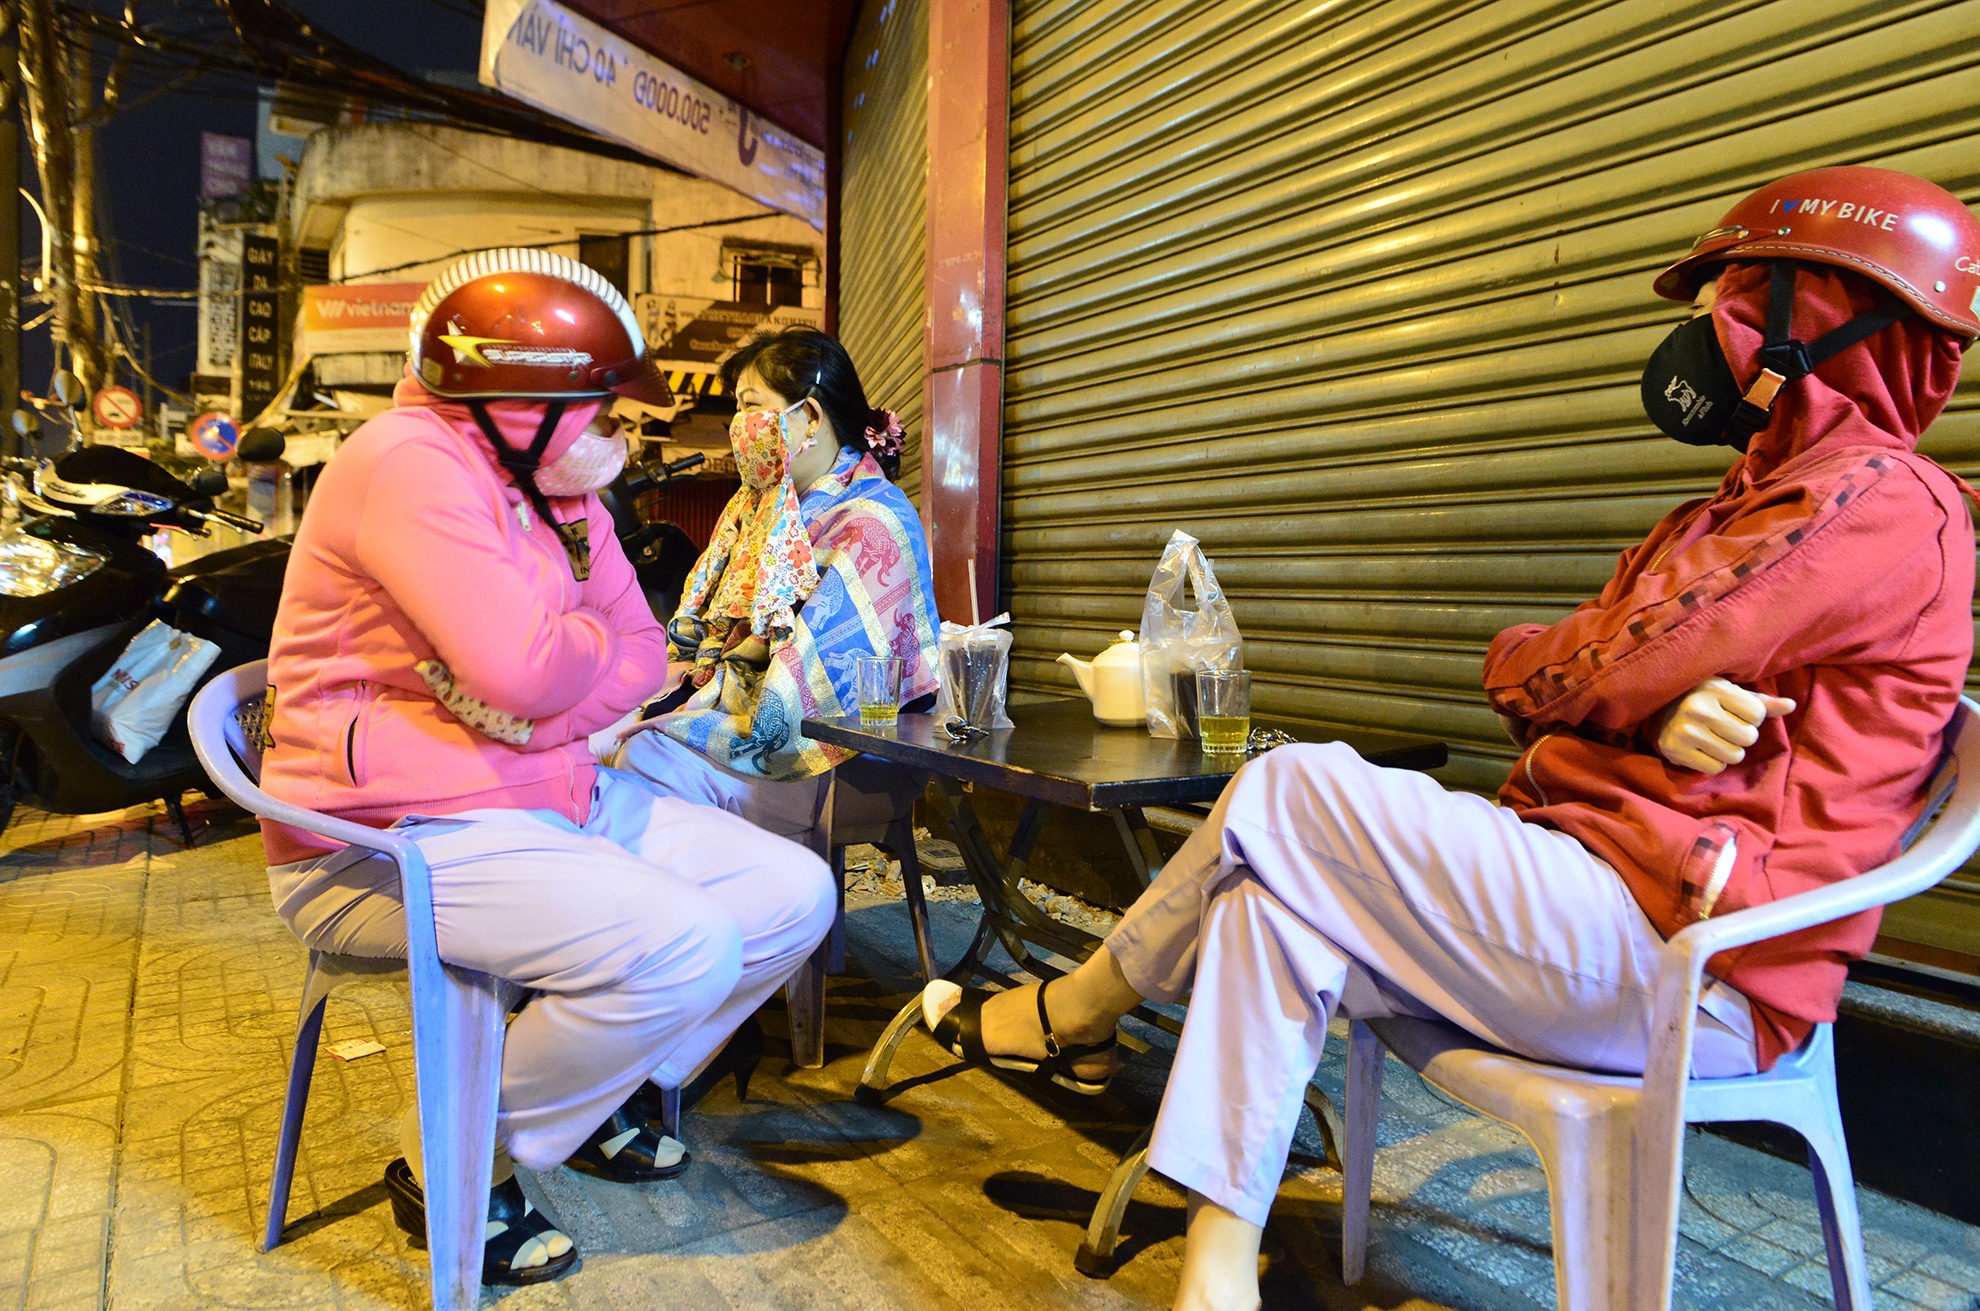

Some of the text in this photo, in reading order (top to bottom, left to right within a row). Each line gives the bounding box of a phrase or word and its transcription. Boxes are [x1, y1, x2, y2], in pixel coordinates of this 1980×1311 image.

[1798, 198, 1838, 216] MY
[1837, 202, 1899, 232] BIKE
[248, 352, 274, 371] ITALY
